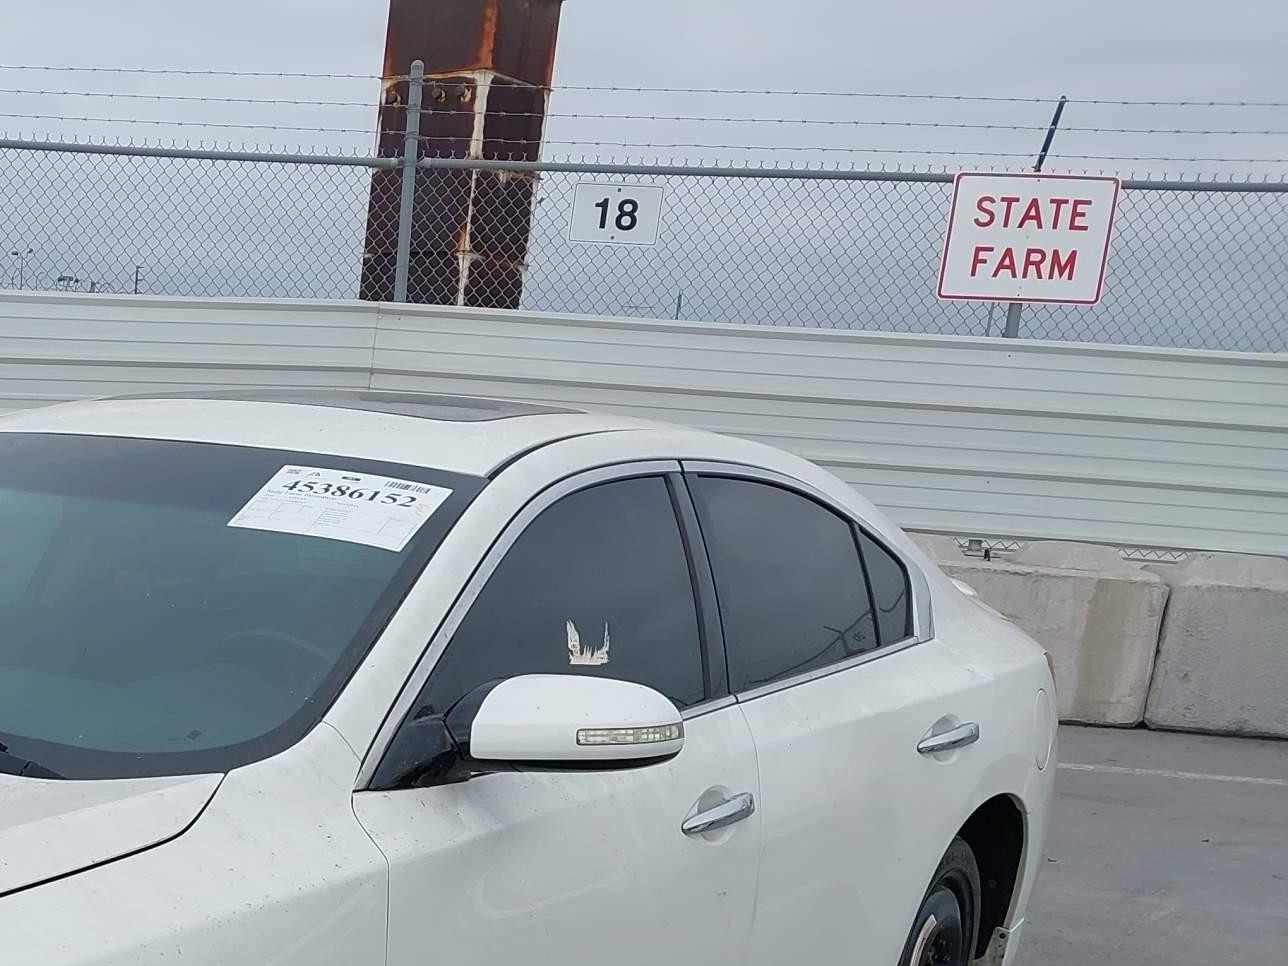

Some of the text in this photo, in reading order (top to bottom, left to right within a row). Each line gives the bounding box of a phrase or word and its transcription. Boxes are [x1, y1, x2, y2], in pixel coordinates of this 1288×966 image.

[594, 197, 639, 231] 18
[973, 195, 1093, 231] STATE
[969, 246, 1079, 281] FARM
[281, 478, 418, 509] 45386152
